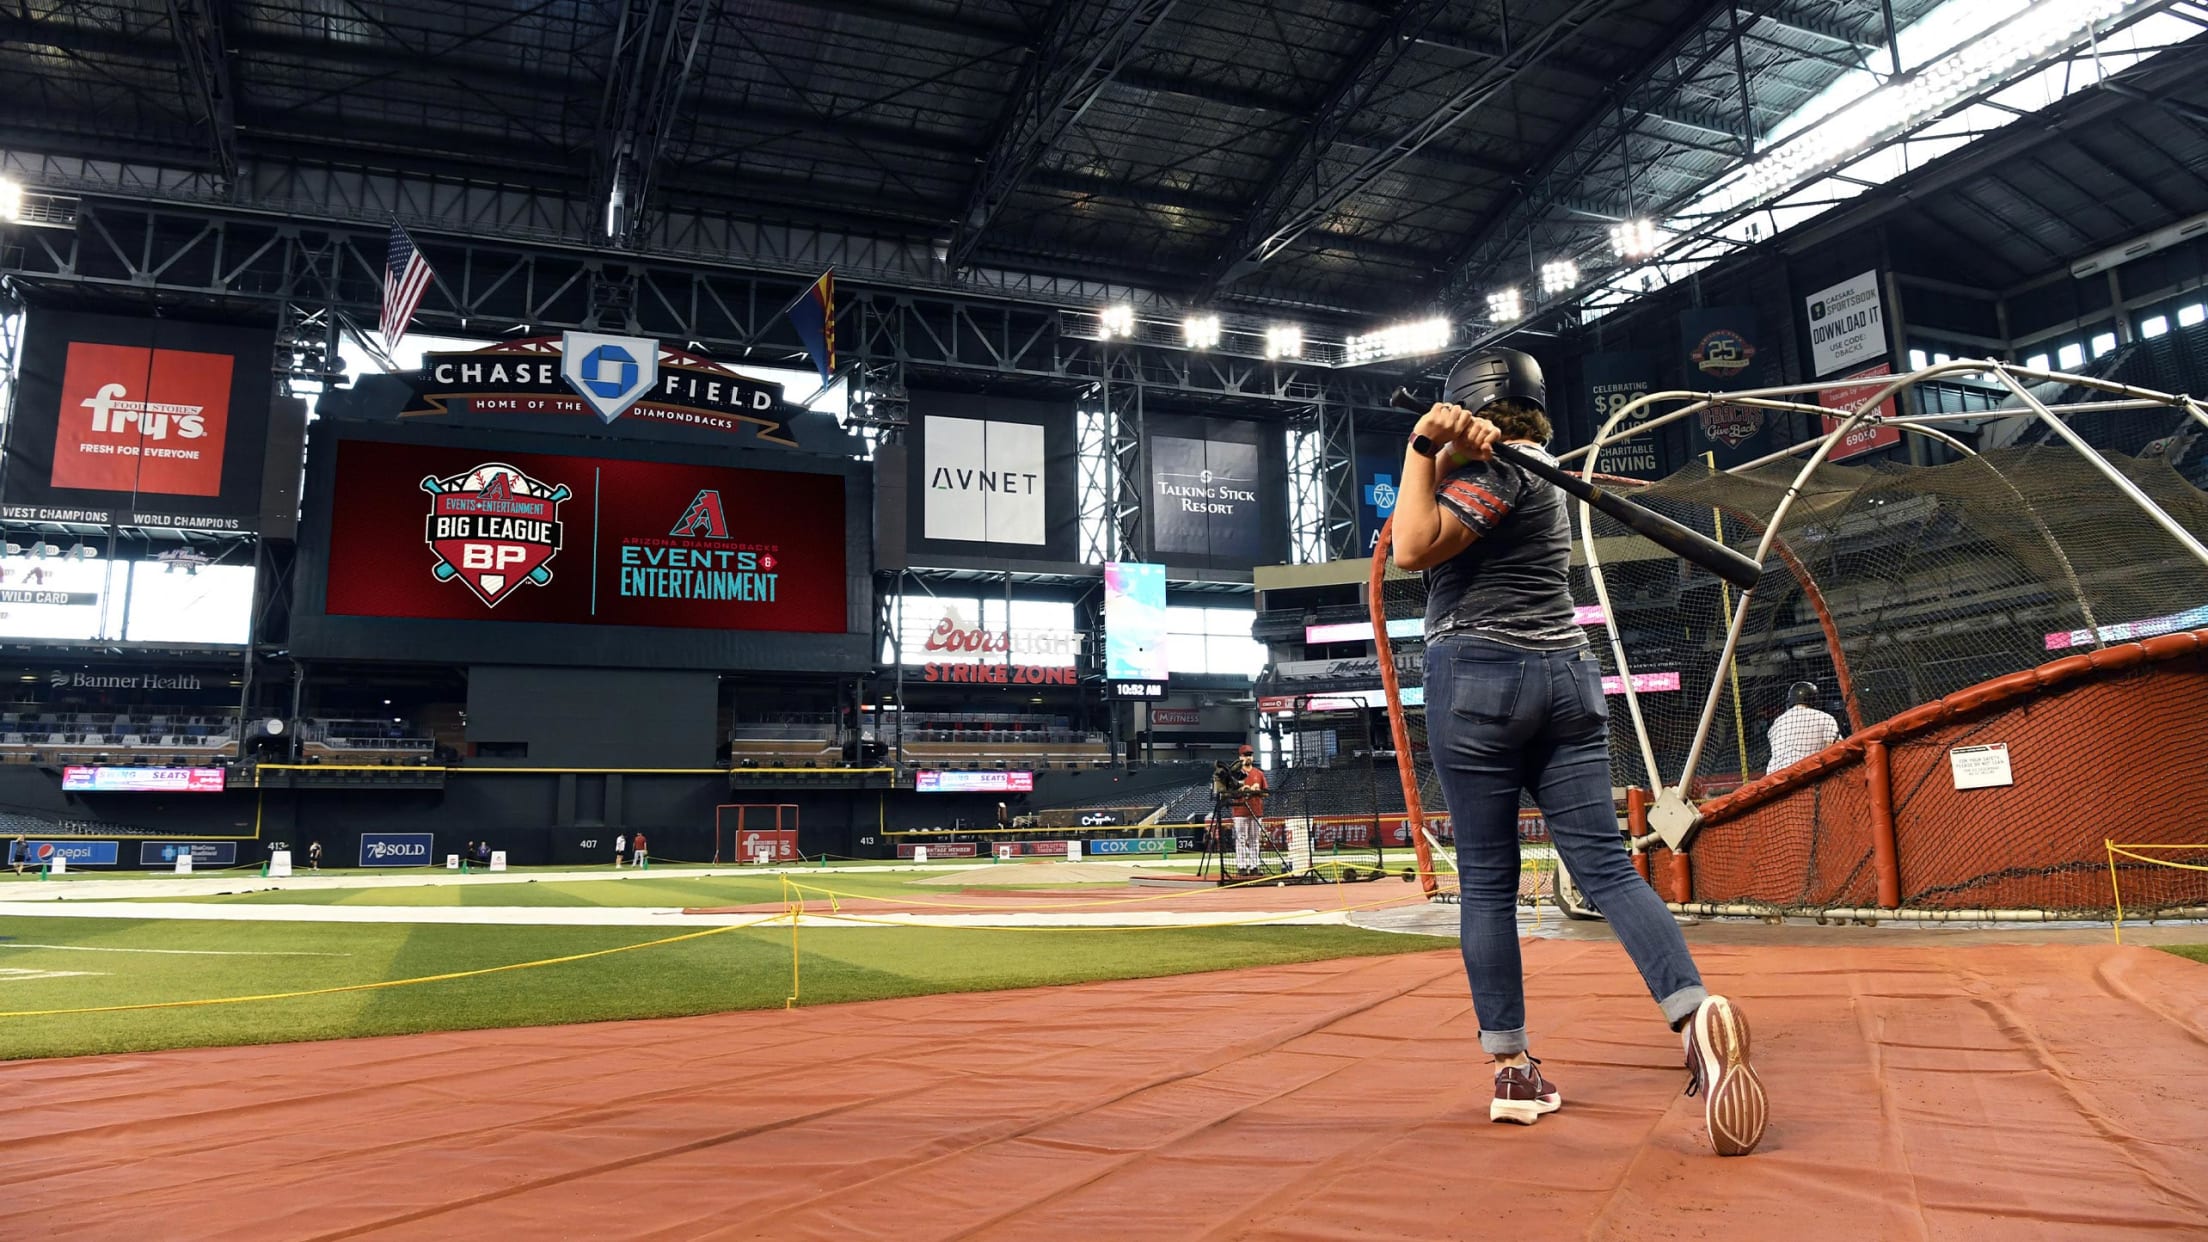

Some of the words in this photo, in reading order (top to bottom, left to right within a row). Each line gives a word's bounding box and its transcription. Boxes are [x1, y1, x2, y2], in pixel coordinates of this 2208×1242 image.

[1826, 289, 1855, 304] CAESARS
[1827, 289, 1876, 315] SPORTSBOOK
[1813, 311, 1866, 344] DOWNLOAD
[1869, 306, 1878, 324] IT
[1709, 340, 1736, 360] 25
[1830, 341, 1842, 352] USE
[1835, 343, 1863, 358] DBACKS
[435, 364, 553, 384] CHASE
[666, 375, 772, 411] FIELD
[1593, 382, 1648, 394] CELEBRATING
[152, 405, 198, 414] STORES
[476, 400, 517, 409] HOME
[528, 401, 545, 409] OF
[557, 402, 582, 411] THE
[634, 407, 733, 429] DIAMONDBACKS
[80, 443, 114, 454] FRESH
[117, 446, 140, 455] FOR
[144, 448, 199, 459] EVERYONE
[1600, 444, 1654, 457] CHARITABLE
[1601, 455, 1656, 473] GIVING
[932, 467, 1037, 494] AVNET
[446, 498, 475, 511] EVENTS
[482, 501, 544, 515] ENTERTAINMENT
[3, 507, 35, 518] WEST
[39, 509, 108, 522] CHAMPIONS
[133, 514, 171, 525] WORLD
[174, 516, 239, 529] CHAMPIONS
[437, 517, 470, 538] BIG
[478, 517, 552, 543] LEAGUE
[622, 537, 678, 546] ARIZONA
[683, 540, 779, 552] DIAMONDBACKS
[463, 543, 526, 570] BP
[622, 546, 757, 570] EVENTS
[621, 567, 778, 602] ENTERTAINMENT
[2, 591, 32, 602] WILD
[36, 592, 68, 604] CARD
[925, 617, 1010, 652] Coors
[1013, 633, 1086, 656] LIGHT
[73, 672, 140, 688] Banner
[142, 674, 201, 689] Health
[925, 662, 1008, 683] STRIKE
[1013, 664, 1078, 685] ZONE
[1117, 684, 1144, 695] 10:52
[1146, 685, 1161, 695] AM
[153, 771, 188, 779] SEATS
[580, 839, 598, 849] 407
[860, 837, 874, 845] 413
[1101, 842, 1128, 851] COX
[1138, 841, 1166, 851] COX
[57, 846, 91, 858] pepsi
